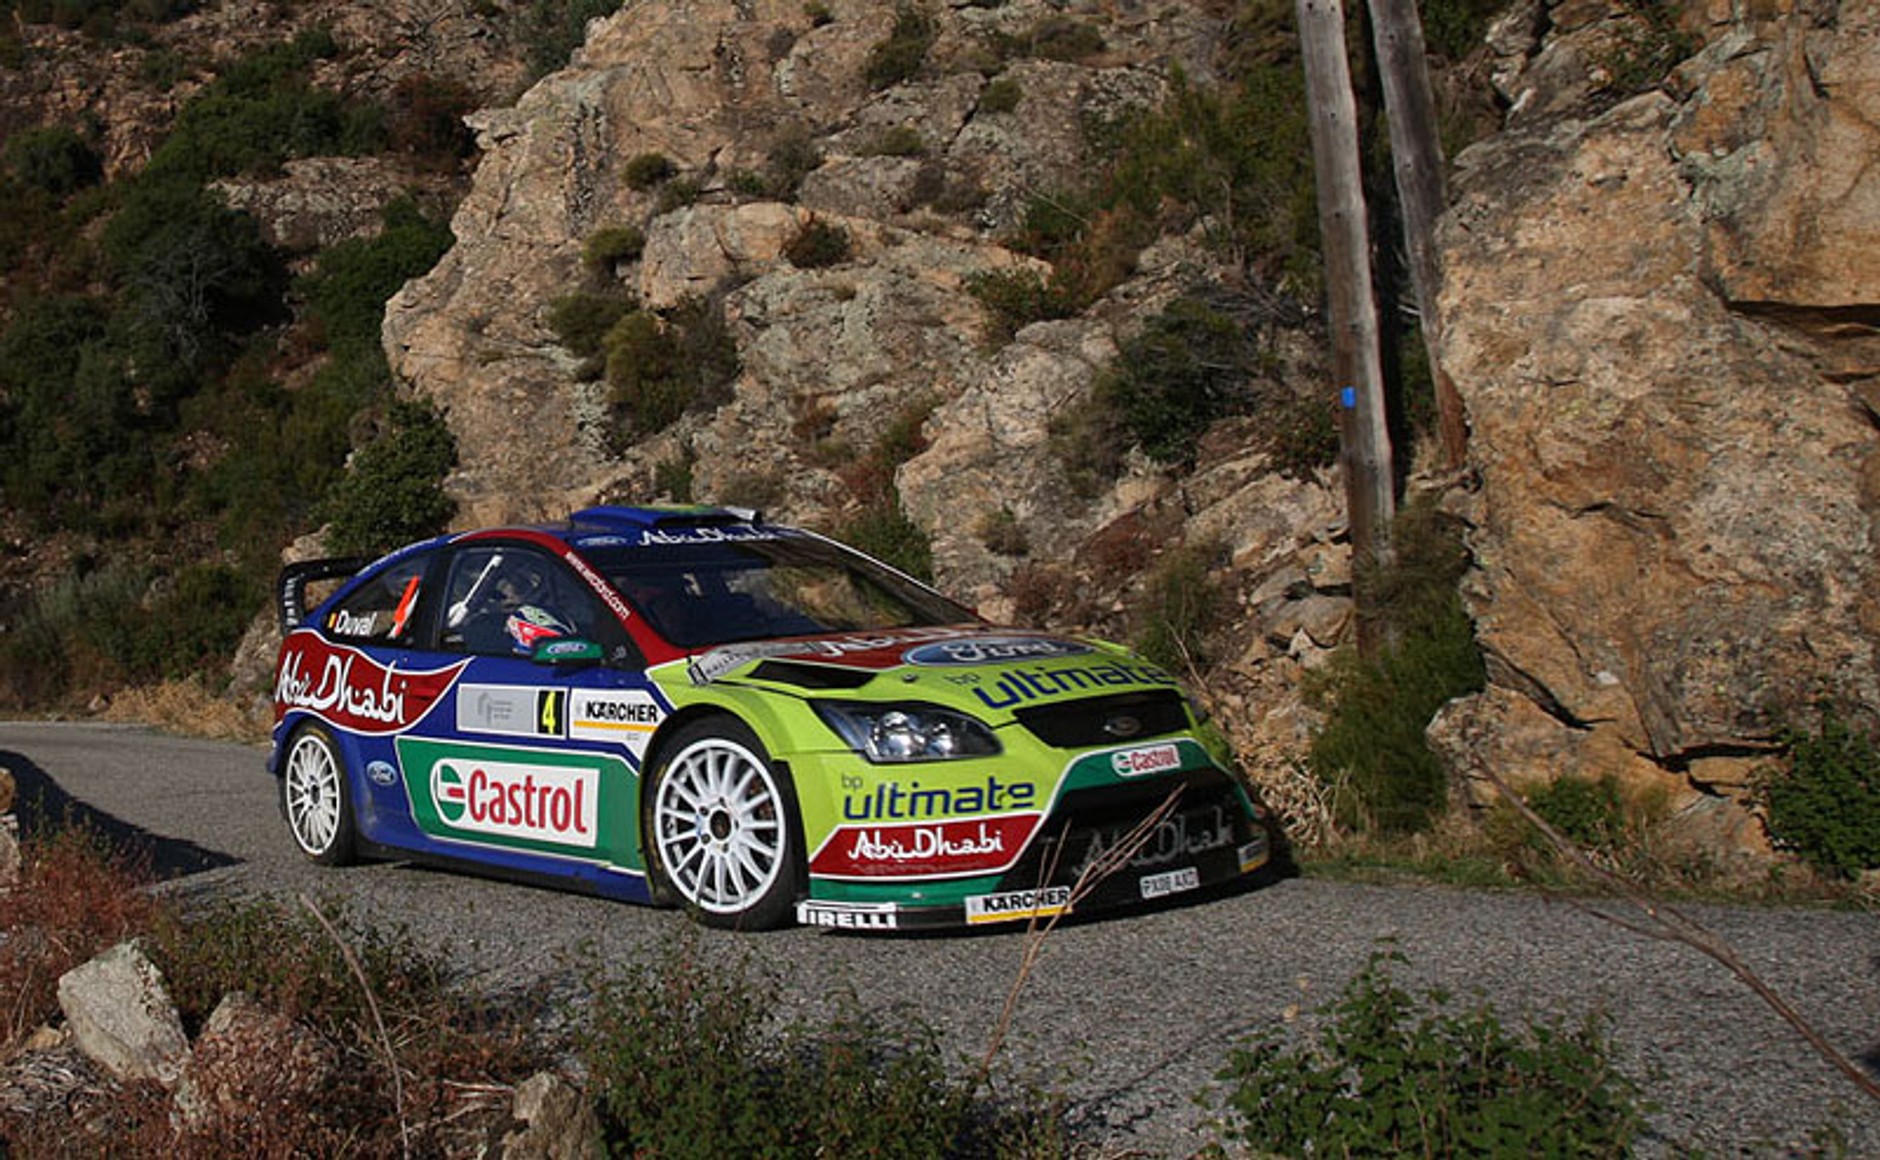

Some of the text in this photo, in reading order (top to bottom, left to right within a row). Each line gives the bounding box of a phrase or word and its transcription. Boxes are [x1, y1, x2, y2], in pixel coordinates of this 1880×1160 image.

[333, 610, 377, 636] Duval
[315, 654, 406, 724] Dhabi
[972, 661, 1177, 710] ultimate
[542, 690, 556, 735] 4
[1131, 747, 1178, 771] Castrol
[468, 769, 588, 834] Castrol
[841, 774, 863, 791] bp
[844, 776, 1035, 820] ultimate
[848, 823, 1004, 863] Abu Dhabi
[797, 899, 897, 929] PIRELLI
